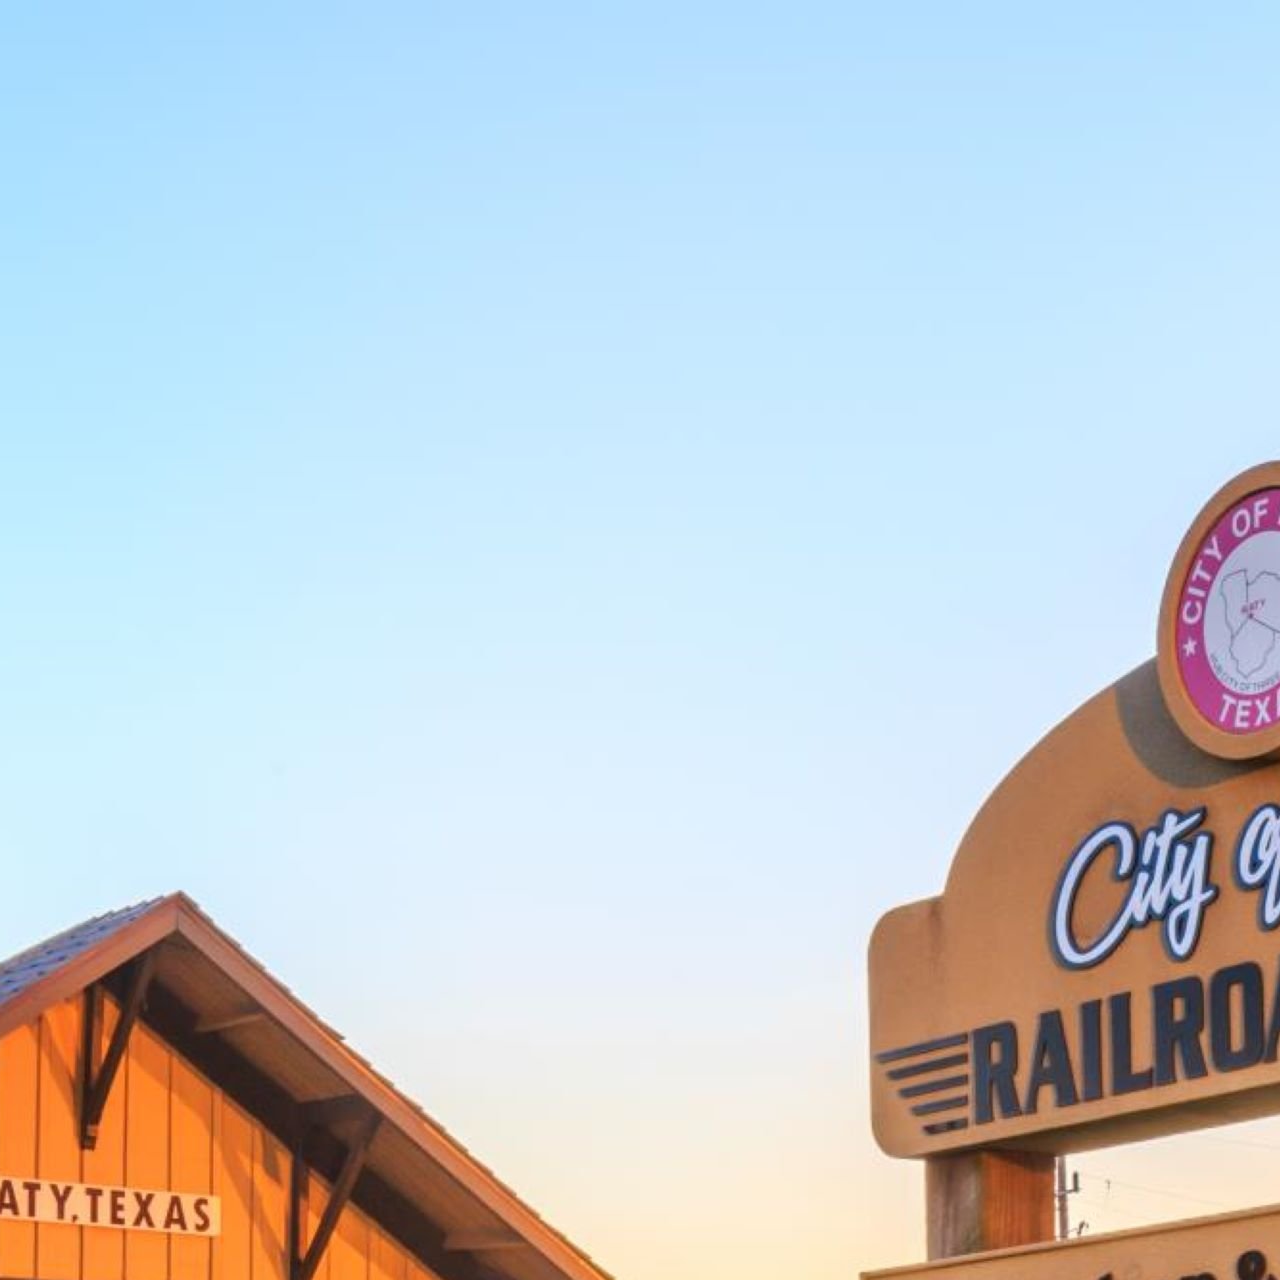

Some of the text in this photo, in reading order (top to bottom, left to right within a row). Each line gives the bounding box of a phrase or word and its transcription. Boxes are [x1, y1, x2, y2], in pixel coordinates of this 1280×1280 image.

[1181, 536, 1222, 624] CITY
[1231, 498, 1269, 538] OF
[1051, 806, 1219, 970] City
